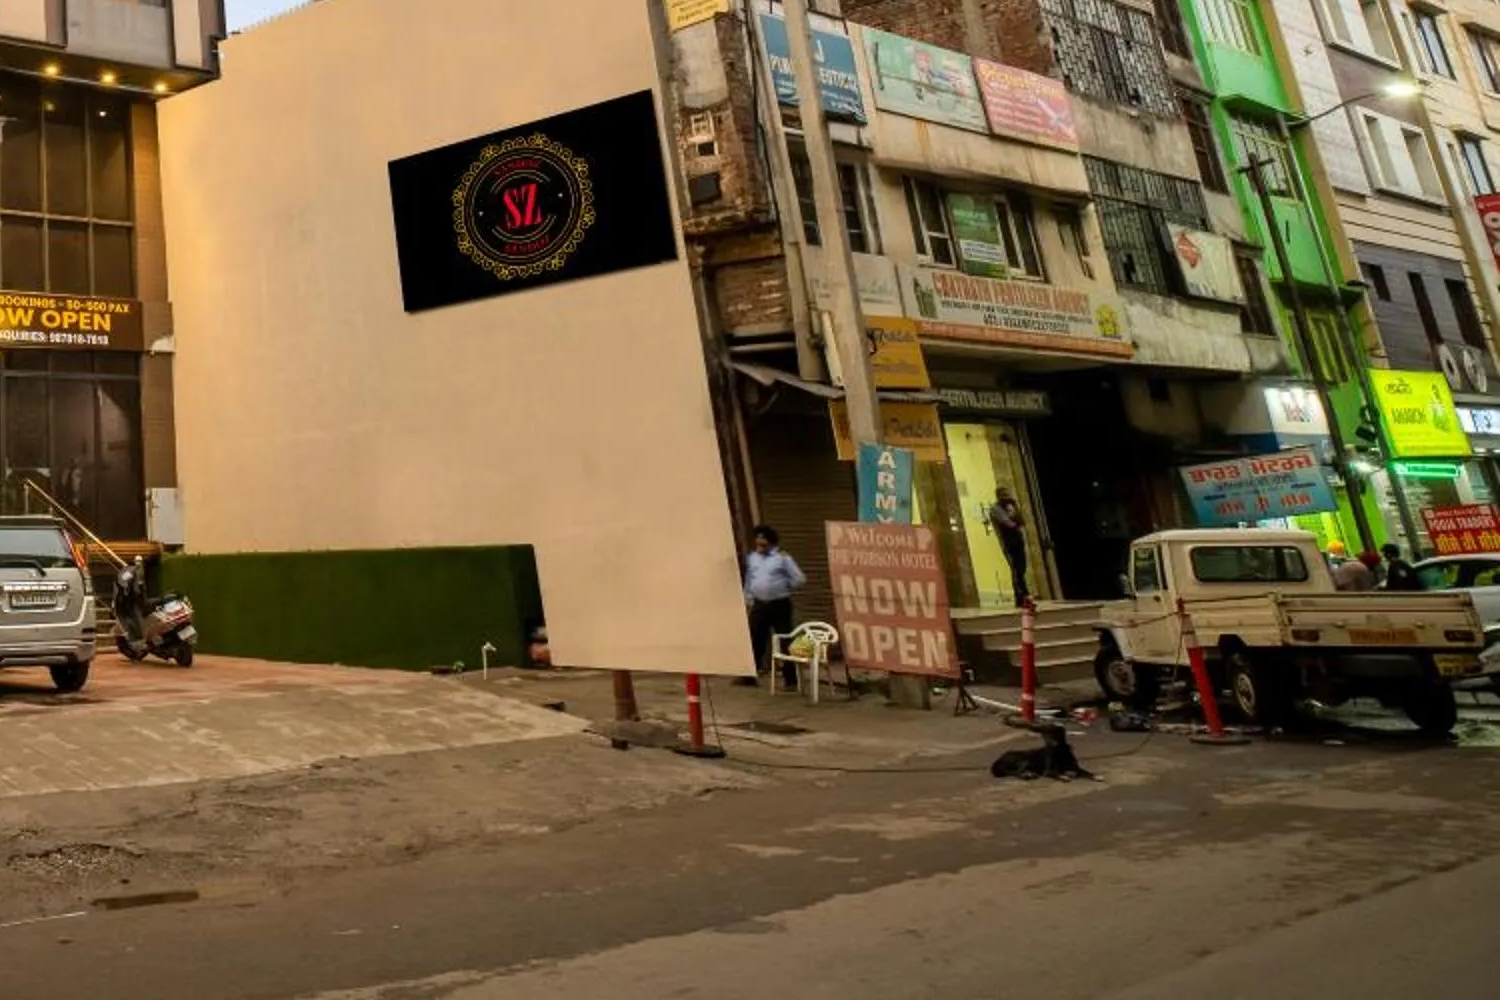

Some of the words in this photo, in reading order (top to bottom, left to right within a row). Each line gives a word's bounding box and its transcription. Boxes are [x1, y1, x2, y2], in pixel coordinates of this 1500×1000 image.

[41, 310, 111, 331] OPEN
[108, 303, 131, 313] PAX
[840, 574, 938, 620] NOW
[842, 620, 952, 670] OPEN
